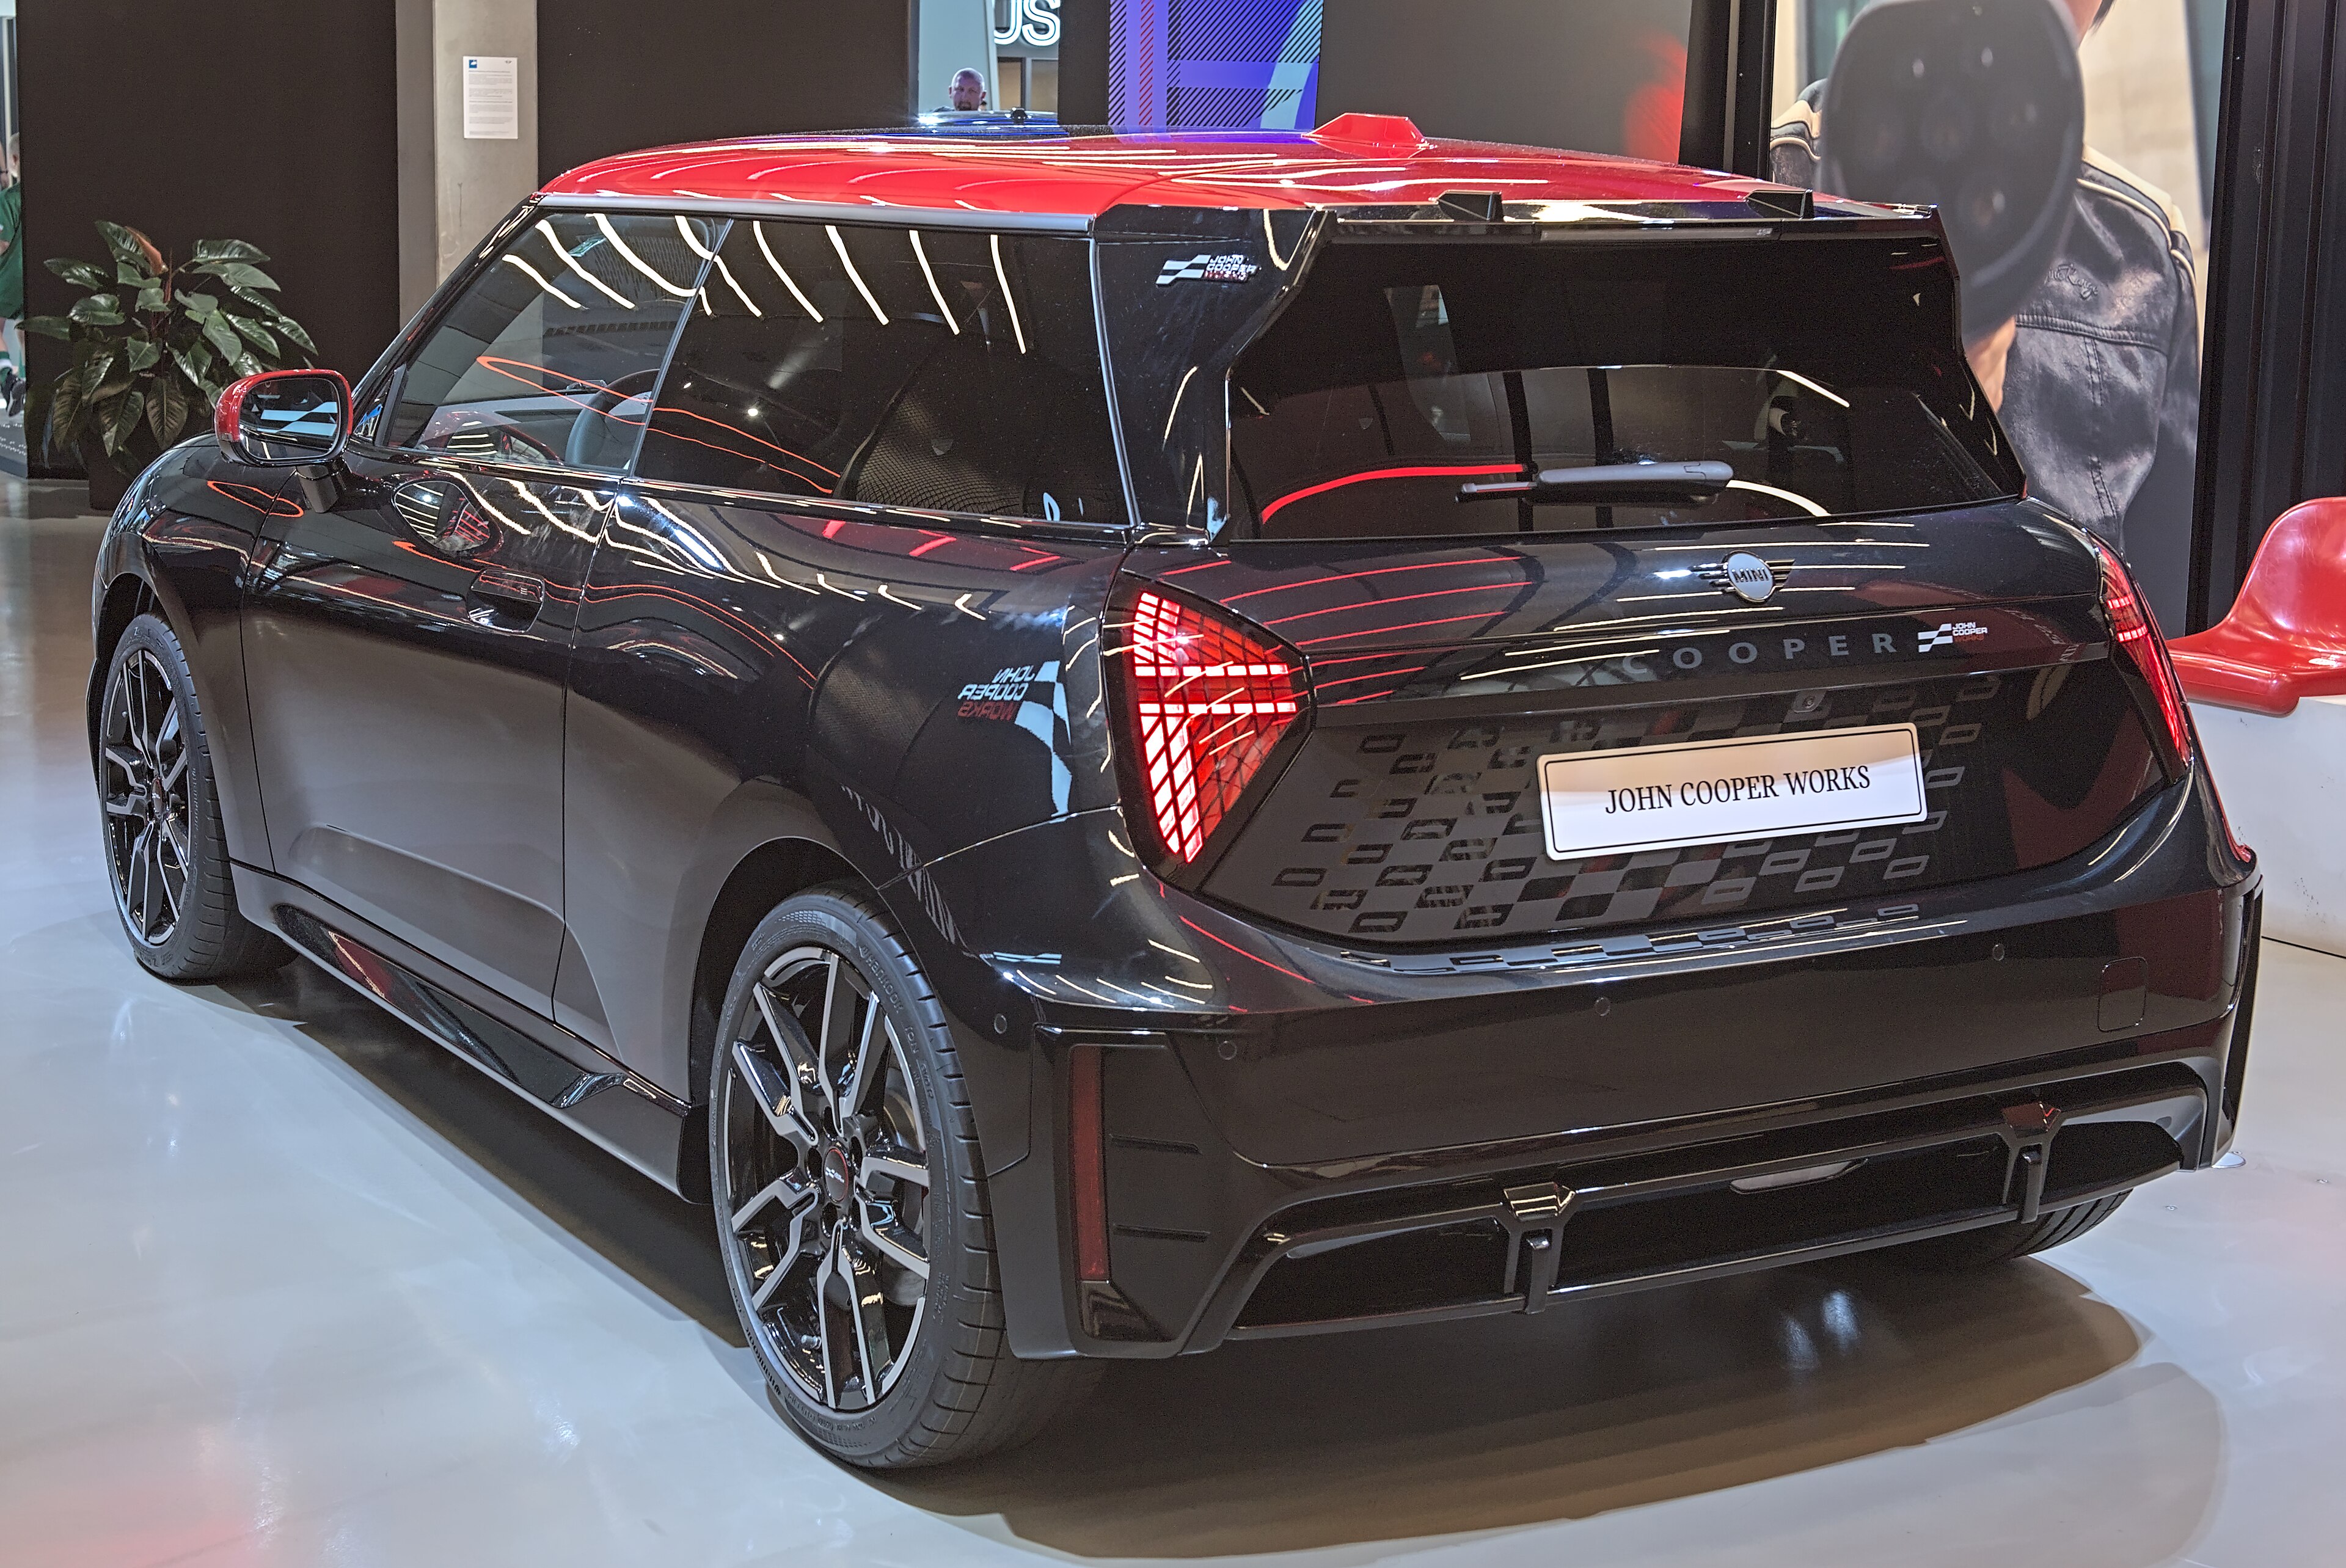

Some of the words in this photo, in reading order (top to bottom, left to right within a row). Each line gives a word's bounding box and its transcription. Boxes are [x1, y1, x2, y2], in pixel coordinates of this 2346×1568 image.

[1209, 254, 1244, 264] JOHN
[1206, 263, 1257, 274] COOPER
[1731, 566, 1770, 583] MINI
[1952, 627, 1988, 636] COOPER
[1621, 632, 1898, 676] COOPER
[1605, 784, 1673, 814] JOHN
[1680, 775, 1780, 806] COOPER
[1783, 765, 1871, 796] WORKS
